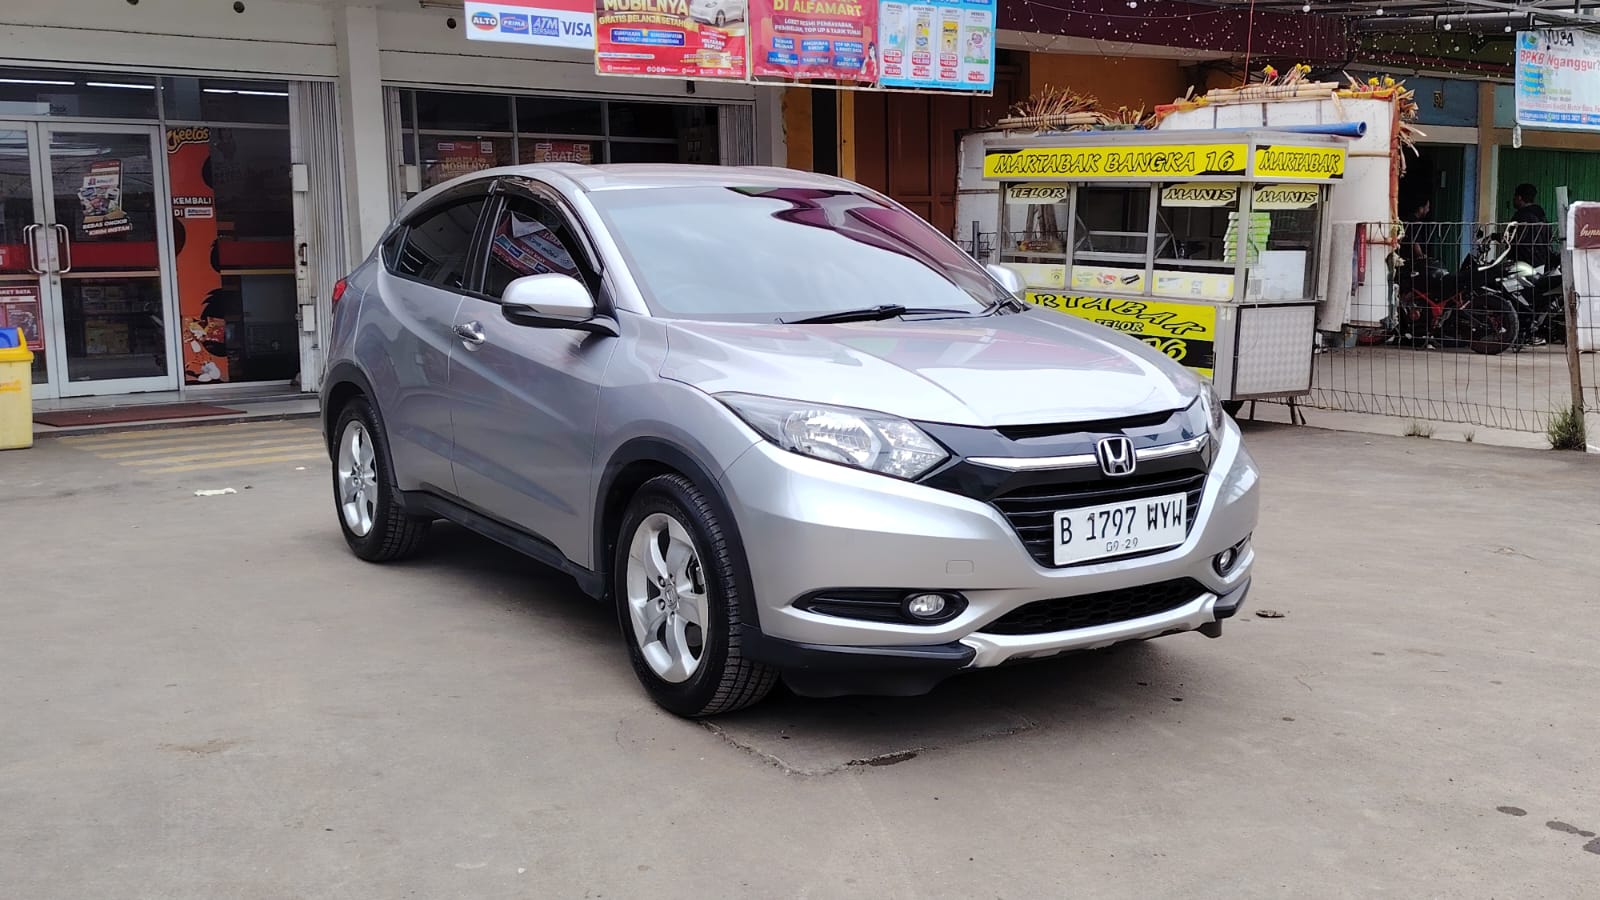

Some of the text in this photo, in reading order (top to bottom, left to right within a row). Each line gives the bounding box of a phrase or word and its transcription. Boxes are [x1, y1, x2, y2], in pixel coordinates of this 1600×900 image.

[604, 0, 689, 17] MOBILNYA
[773, 0, 862, 17] DI ALFAMART
[473, 17, 497, 26] ALTO
[503, 20, 526, 28] PRIMA
[533, 17, 558, 30] ATM
[599, 15, 627, 25] GRATIS
[562, 20, 593, 37] VISA
[1520, 50, 1545, 65] BPKB
[167, 128, 209, 150] Cheetos
[545, 151, 583, 163] GRATIS
[993, 150, 1235, 174] MARTABAK BANGKA 16
[1258, 151, 1341, 174] MARTABAK
[1009, 186, 1068, 200] TELOR
[1163, 187, 1236, 202] MANIS
[1256, 189, 1318, 203] MANIS
[173, 197, 212, 206] KEMBALI
[174, 209, 184, 217] DI
[1095, 318, 1144, 333] TELOR
[1060, 498, 1183, 546] B 1797 WYW
